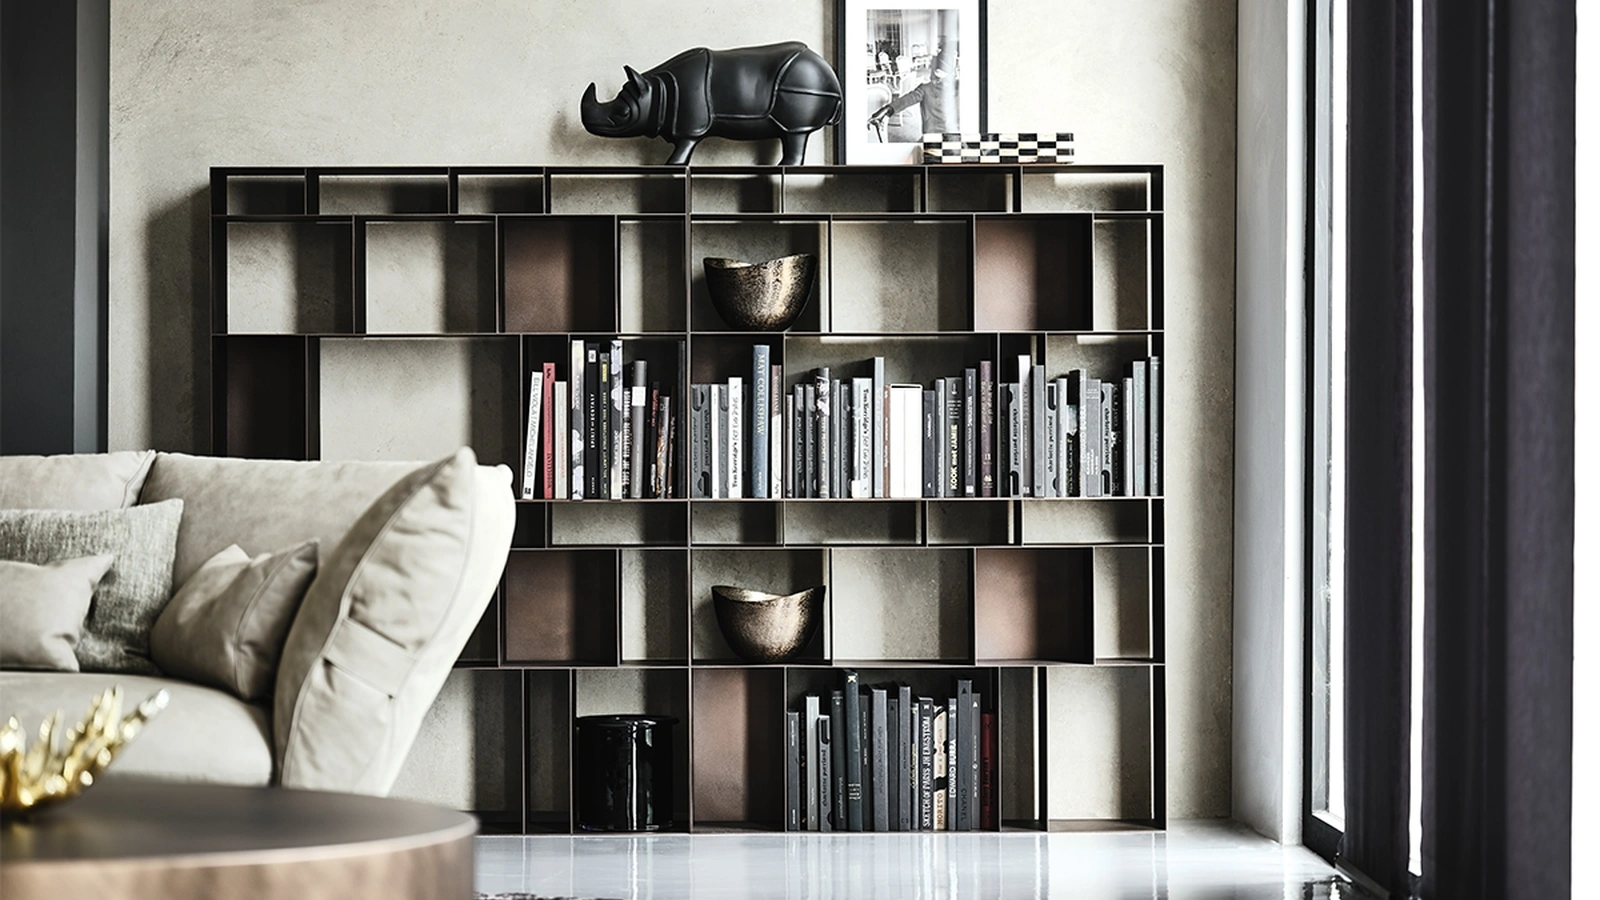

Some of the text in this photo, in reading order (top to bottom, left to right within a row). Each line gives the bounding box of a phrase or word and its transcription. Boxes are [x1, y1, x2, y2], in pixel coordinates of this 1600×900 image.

[757, 377, 766, 435] COLLISHAW
[950, 424, 958, 449] JAMIE
[950, 467, 958, 490] KOOK
[949, 738, 957, 798] EDWARD BURRA
[923, 798, 931, 827] SKETCH
[960, 787, 969, 821] CHANEL
